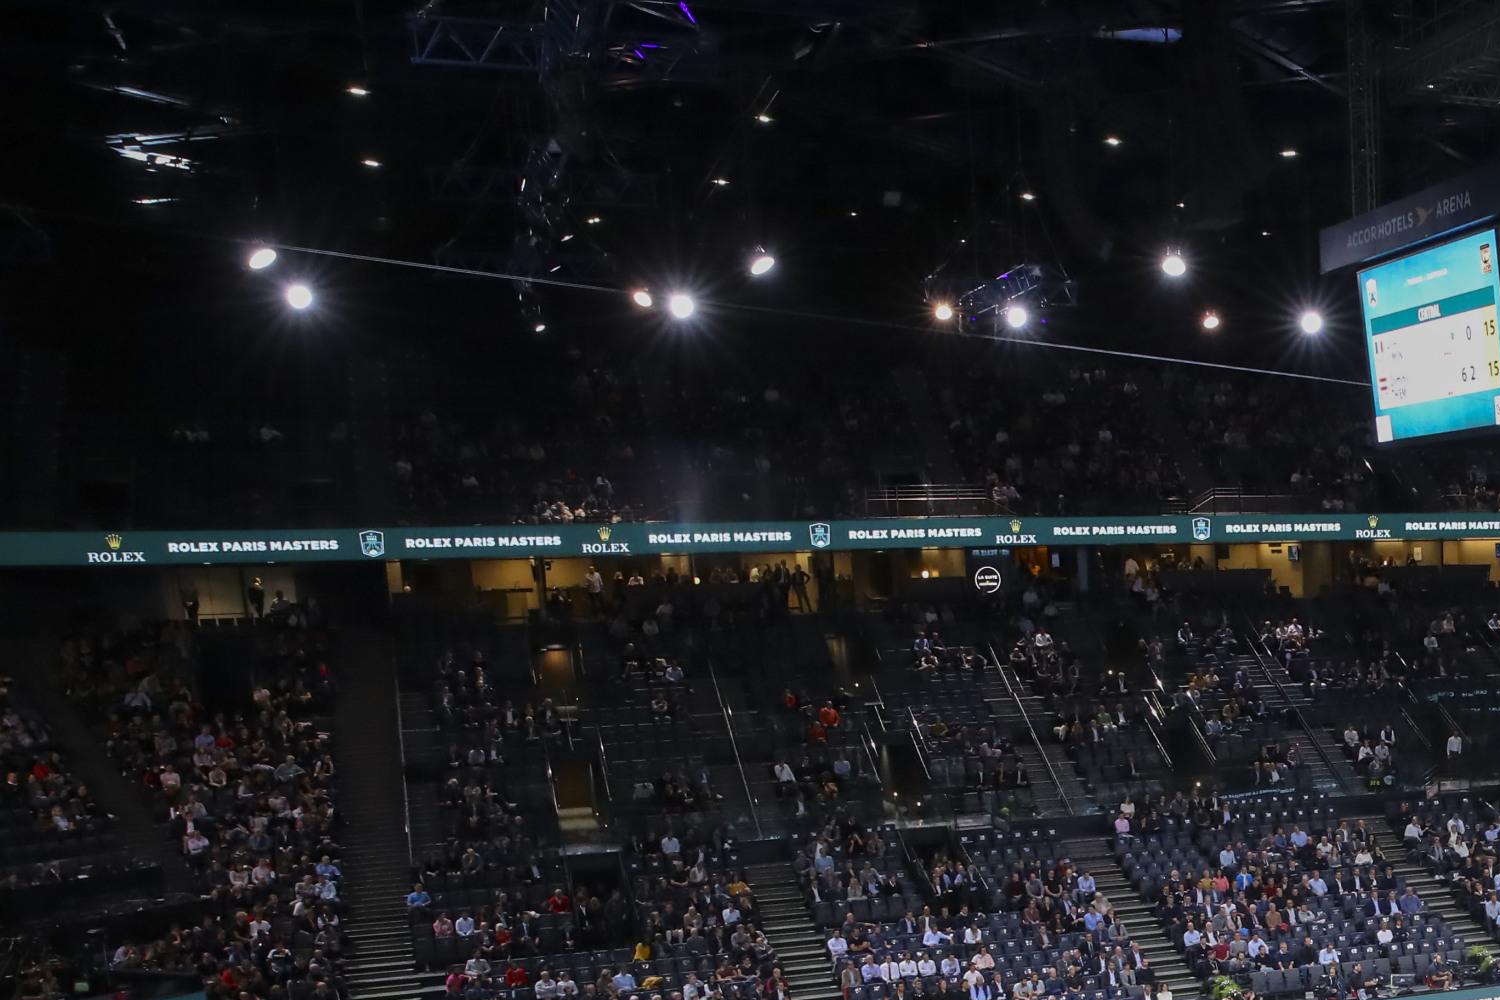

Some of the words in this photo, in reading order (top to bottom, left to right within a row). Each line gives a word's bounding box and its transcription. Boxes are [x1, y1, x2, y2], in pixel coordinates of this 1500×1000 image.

[1347, 228, 1377, 248] ACCOR
[1378, 213, 1414, 239] HOTELS
[1436, 192, 1471, 218] ARENA
[1465, 325, 1472, 341] 0
[1484, 319, 1496, 337] 15
[1461, 367, 1468, 382] 6
[1470, 365, 1476, 380] 2
[1488, 360, 1500, 377] 15
[1054, 526, 1089, 536] ROLEX
[1093, 525, 1125, 535] PARIS
[1127, 525, 1177, 535] MASTERS
[1226, 524, 1260, 533] ROLEX
[1263, 523, 1292, 533] PARIS
[1295, 523, 1341, 532] MASTERS
[1406, 522, 1437, 531] ROLEX
[1439, 521, 1466, 530] PARIS
[649, 533, 691, 544] ROLEX
[694, 532, 731, 543] PARIS
[734, 531, 792, 542] MASTERS
[849, 529, 888, 540] ROLEX
[891, 528, 926, 539] PARIS
[928, 527, 982, 538] MASTERS
[995, 534, 1037, 544] ROLEX
[1356, 529, 1391, 538] ROLEX
[168, 542, 219, 553] ROLEX
[223, 541, 266, 552] PARIS
[270, 539, 339, 551] MASTERS
[406, 537, 452, 548] ROLEX
[455, 537, 496, 547] PARIS
[499, 536, 562, 547] MASTERS
[582, 542, 630, 553] ROLEX
[88, 551, 146, 563] ROLEX
